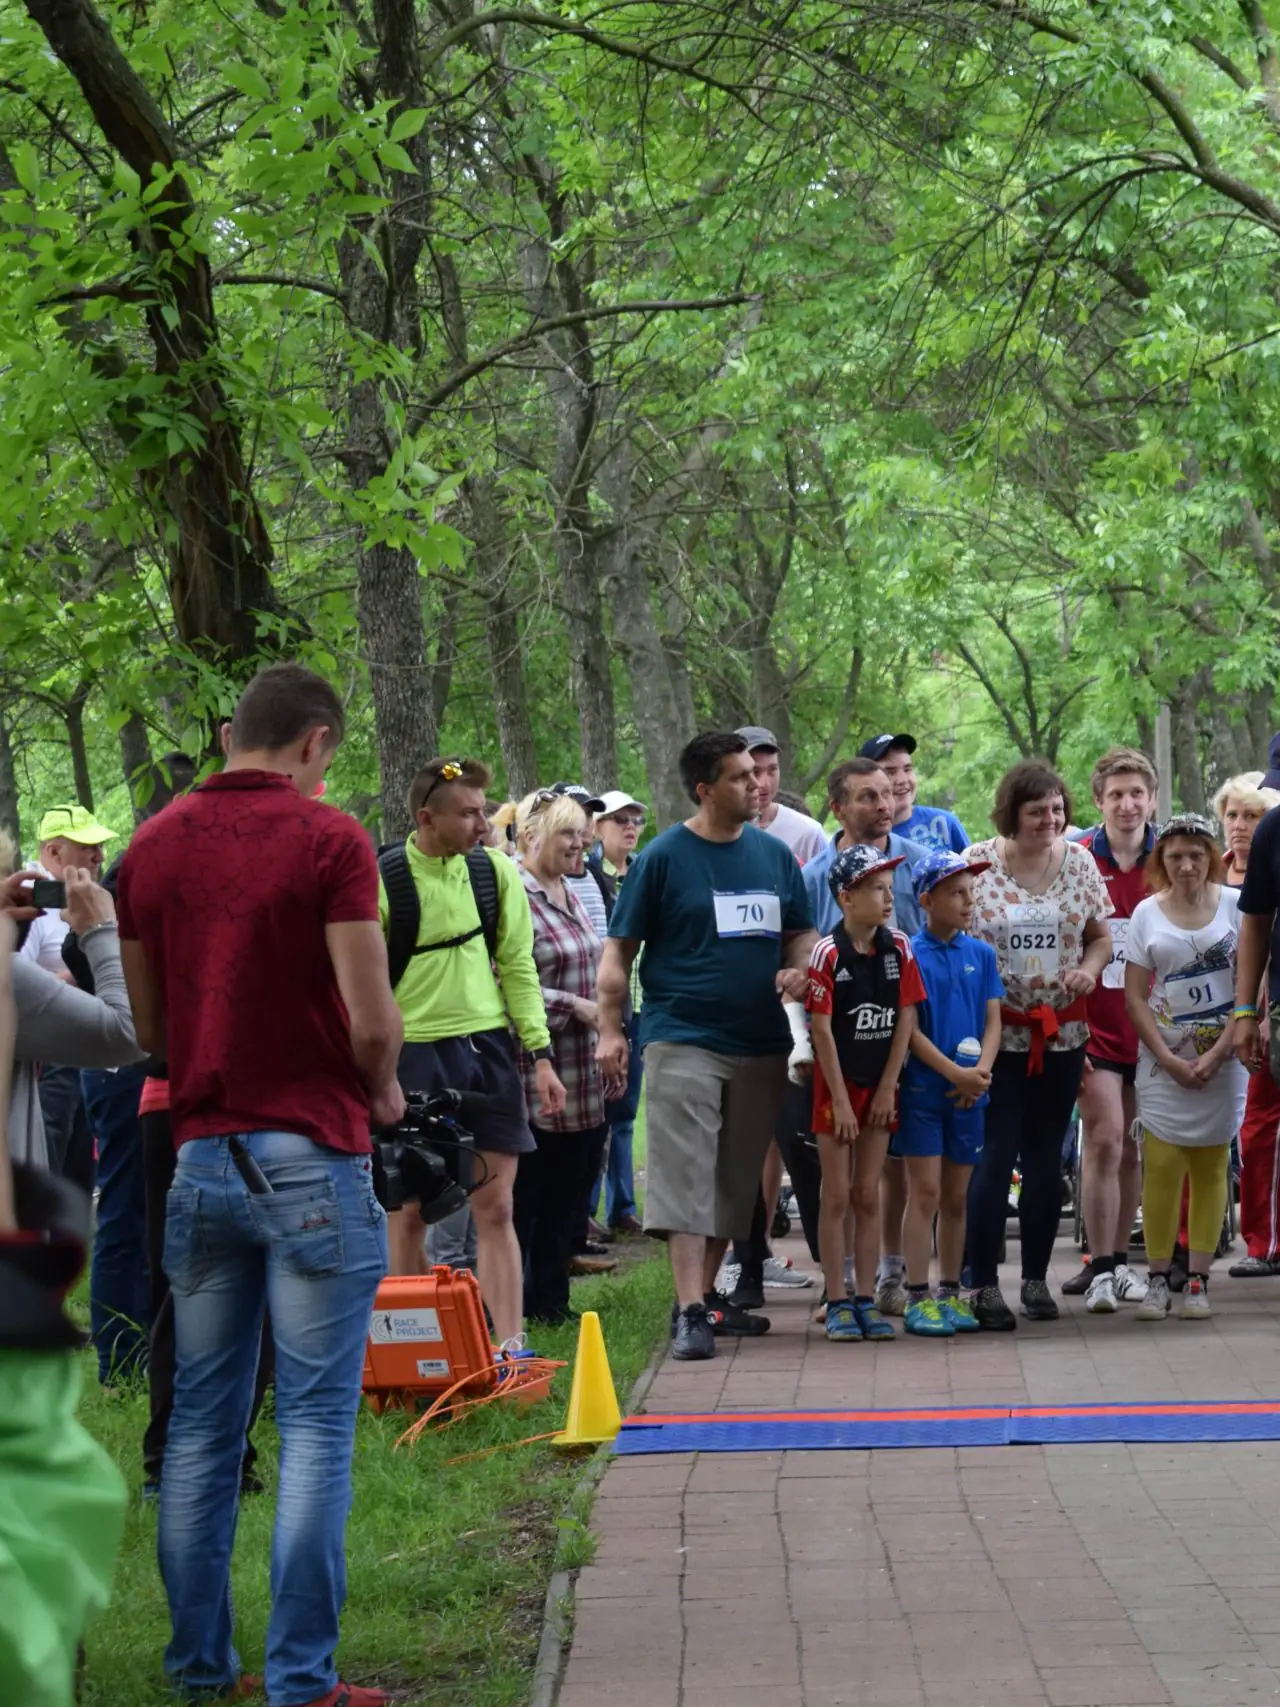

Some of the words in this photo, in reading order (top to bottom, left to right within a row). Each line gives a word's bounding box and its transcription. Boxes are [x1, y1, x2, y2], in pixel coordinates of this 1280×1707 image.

[736, 903, 764, 923] 70
[1010, 934, 1056, 950] 0522
[1188, 983, 1213, 1008] 91
[856, 1007, 896, 1030] Brit
[854, 1029, 892, 1041] Insurance
[395, 1327, 437, 1337] PROJECT
